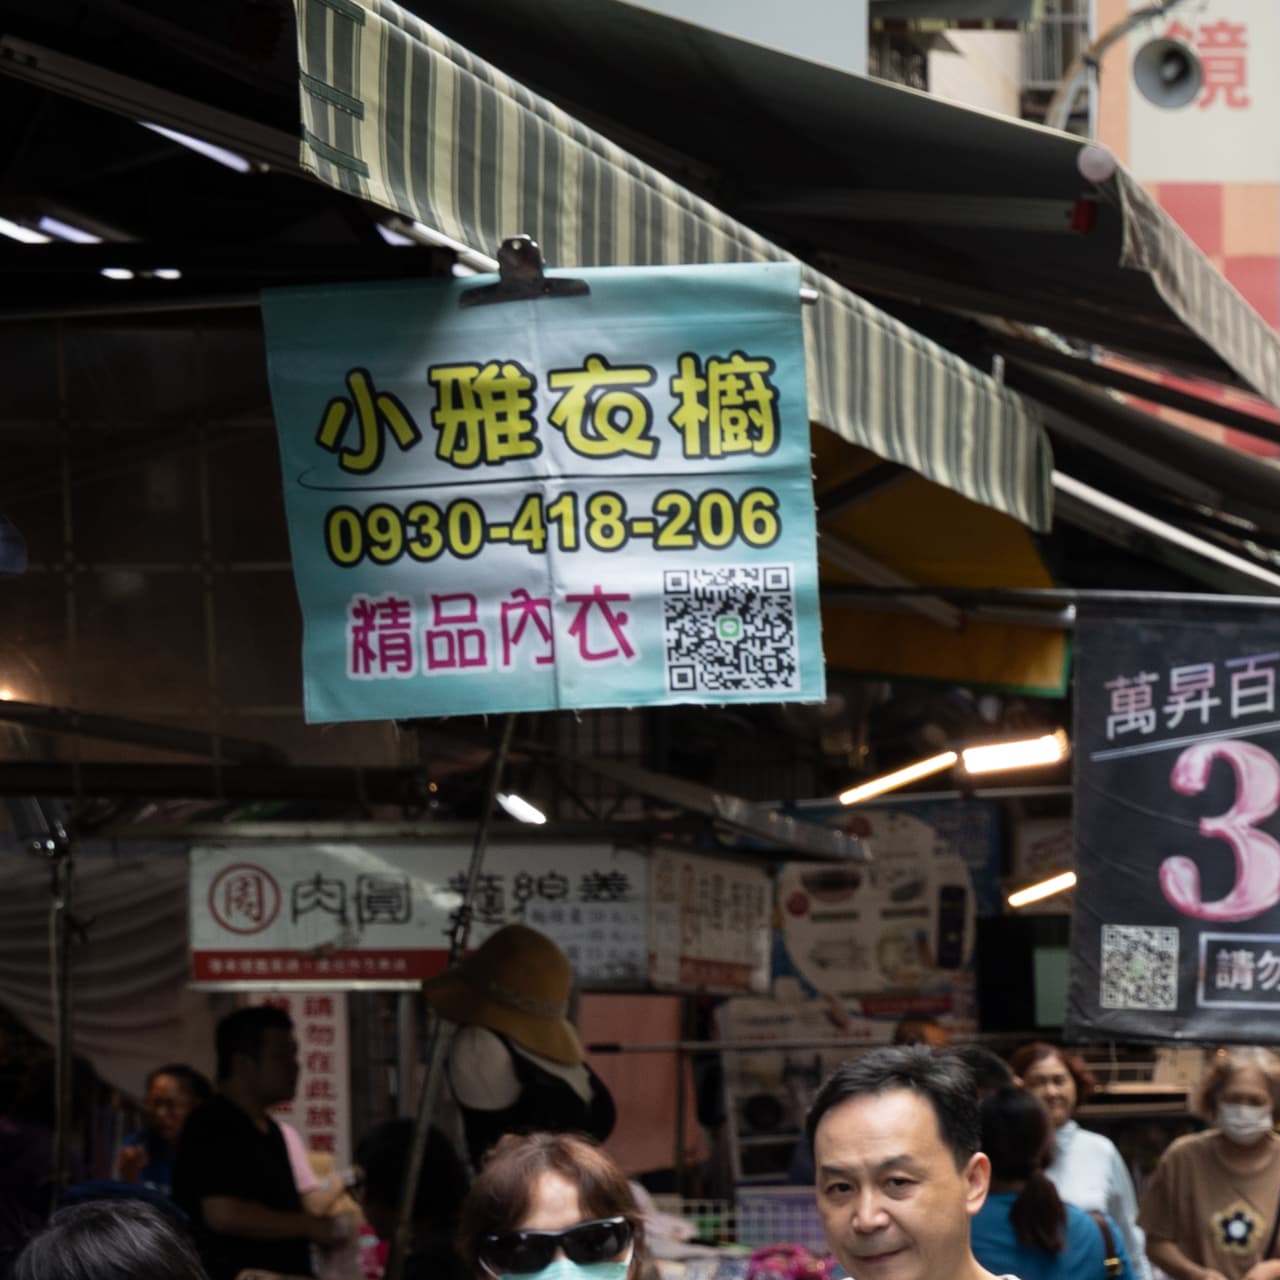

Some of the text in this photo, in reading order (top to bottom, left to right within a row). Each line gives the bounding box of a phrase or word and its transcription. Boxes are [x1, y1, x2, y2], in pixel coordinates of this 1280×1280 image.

[315, 350, 778, 479] 小雅衣櫥
[325, 487, 780, 568] 0930-418-206
[350, 583, 637, 676] 精品內衣
